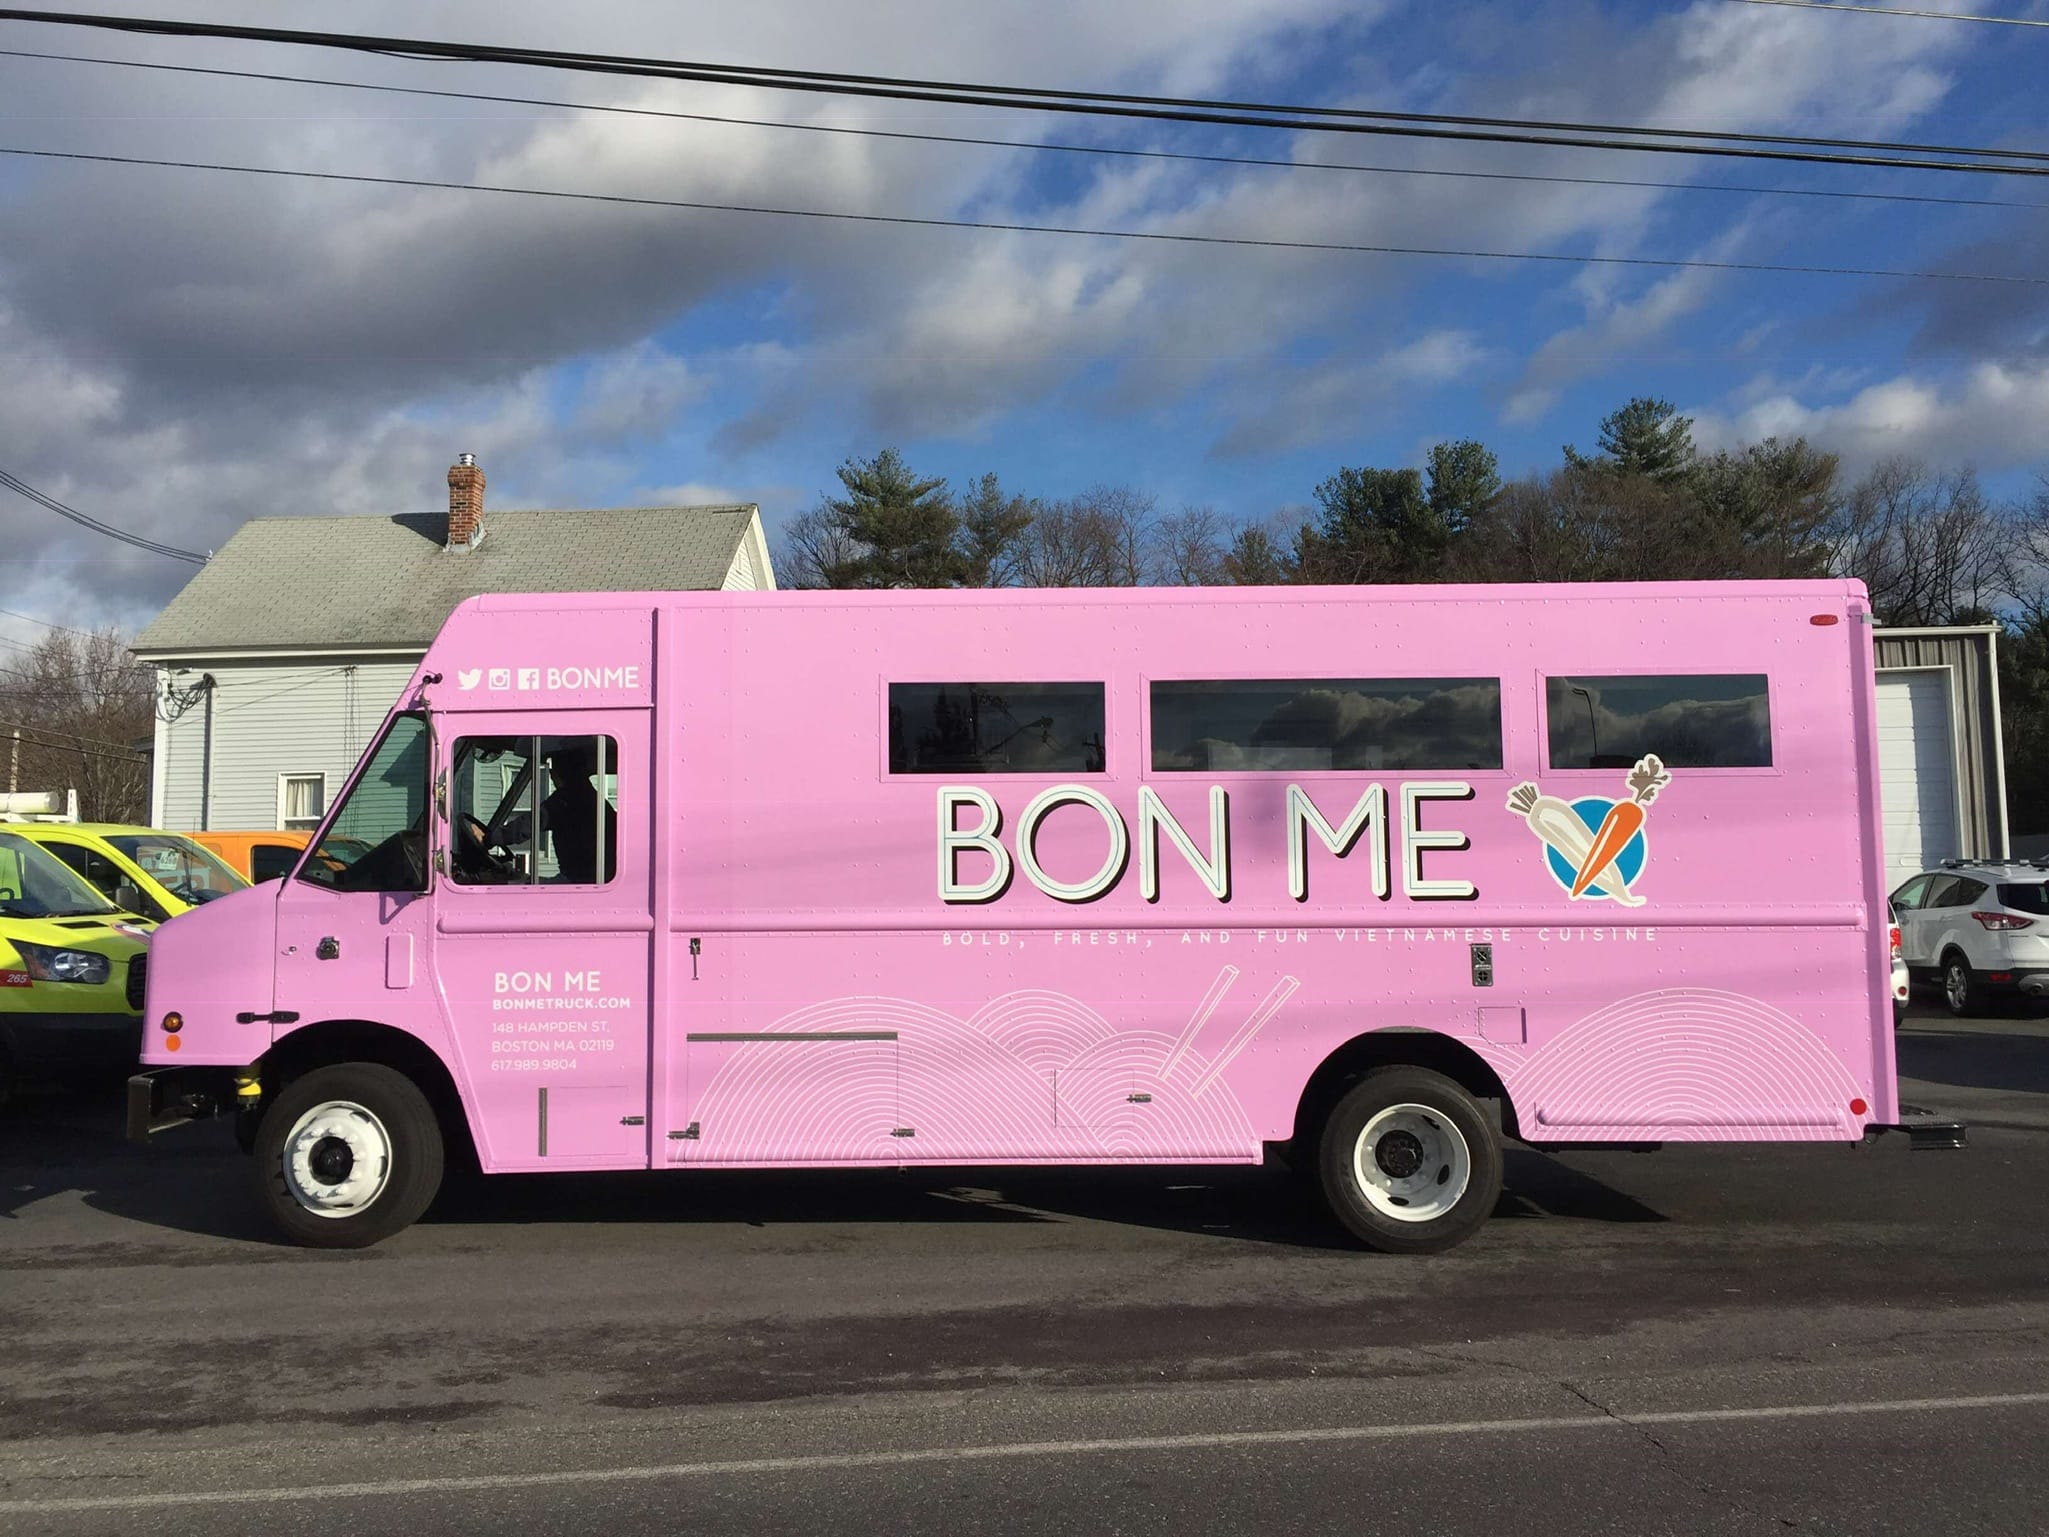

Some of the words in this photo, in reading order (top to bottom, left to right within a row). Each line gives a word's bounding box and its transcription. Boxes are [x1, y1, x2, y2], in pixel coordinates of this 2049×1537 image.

[547, 666, 639, 690] BONME
[937, 785, 1230, 903] BON
[1286, 782, 1479, 901] ME
[943, 931, 1025, 949] BOLD,
[1054, 930, 1152, 948] FRESH,
[1181, 929, 1231, 944] AND
[1257, 929, 1308, 943] FUN
[1335, 929, 1511, 942] VIETNAMESE
[1538, 928, 1656, 941] CUISINE
[6, 973, 28, 984] 265
[494, 971, 552, 993] BON
[564, 970, 601, 992] ME
[492, 997, 631, 1011] BONMETRUCK.COM
[492, 1022, 514, 1034] 148
[517, 1021, 588, 1033] HAMPDEN
[591, 1020, 610, 1033] ST.
[491, 1040, 550, 1053] BOSTON
[554, 1040, 576, 1052] MA
[579, 1039, 615, 1052] 02119
